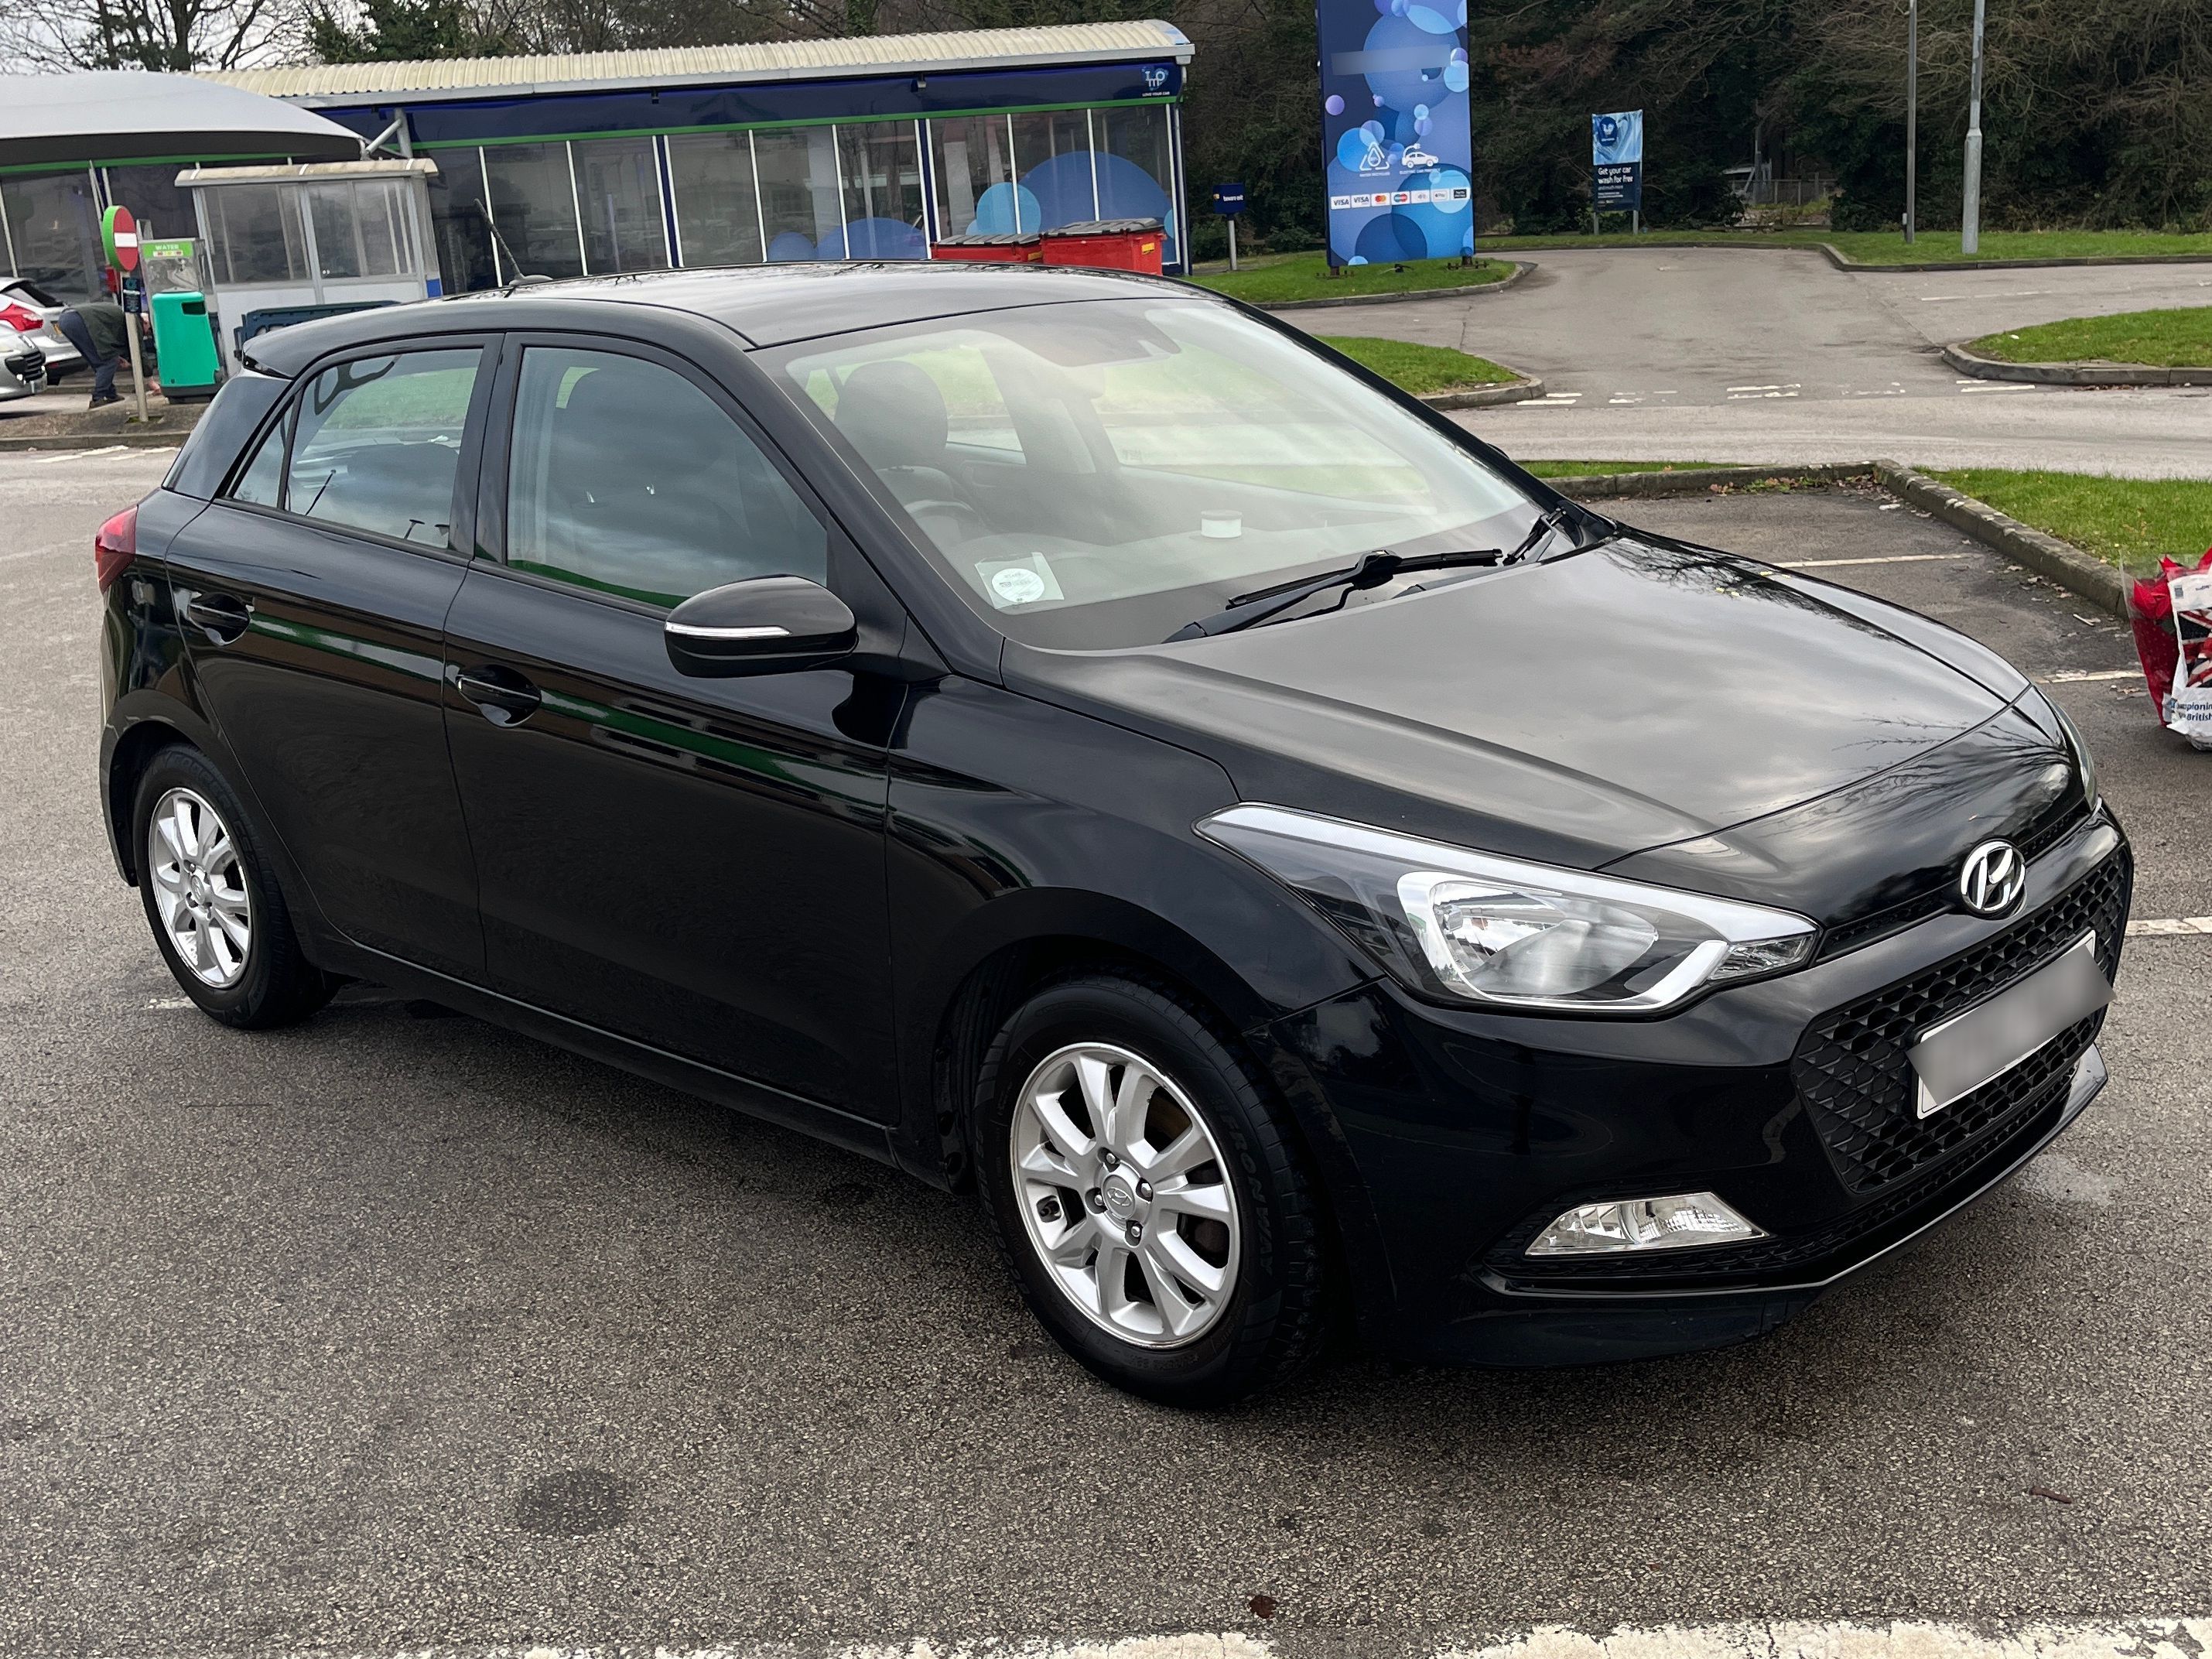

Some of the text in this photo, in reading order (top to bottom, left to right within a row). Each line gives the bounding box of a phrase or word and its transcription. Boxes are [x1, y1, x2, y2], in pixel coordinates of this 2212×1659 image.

[1609, 167, 1621, 176] your
[1623, 174, 1633, 183] free
[1333, 198, 1349, 207] VISA
